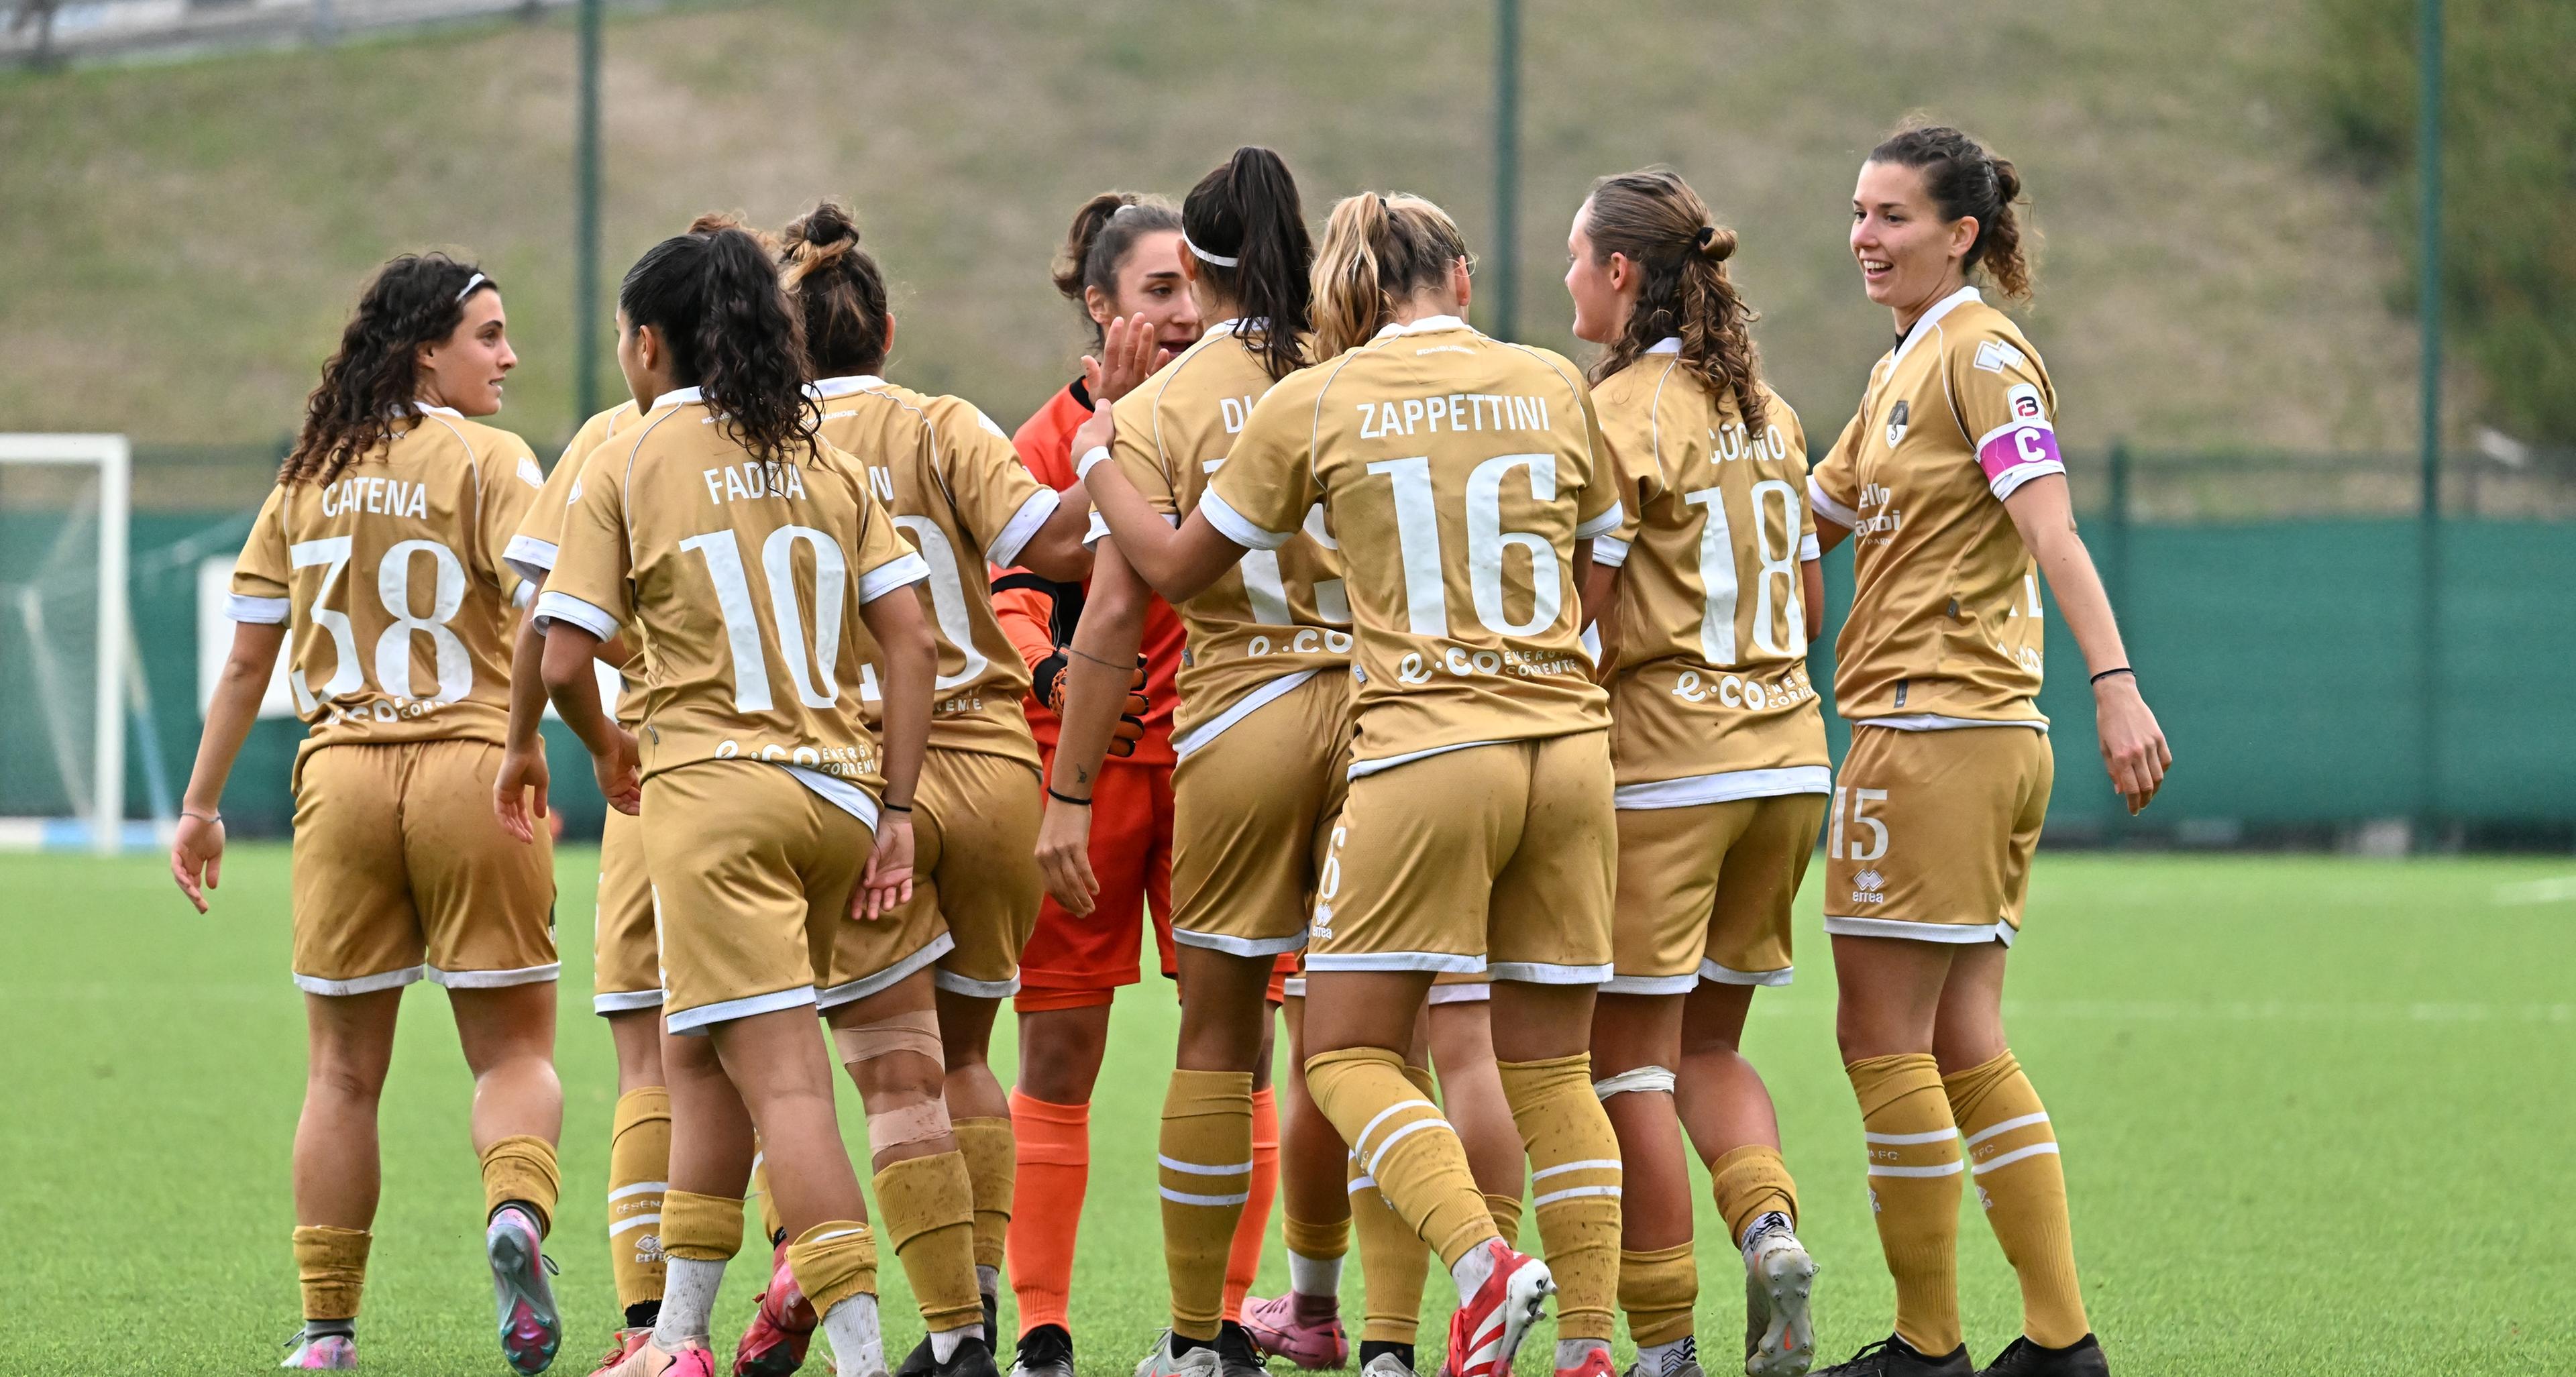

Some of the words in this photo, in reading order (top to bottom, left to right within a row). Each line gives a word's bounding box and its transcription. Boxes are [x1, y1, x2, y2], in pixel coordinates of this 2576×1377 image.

[1356, 394, 1550, 439] ZAPPETTINI
[2015, 426, 2046, 461] C
[322, 477, 427, 520] CATENA
[703, 461, 806, 505] FADDA
[1366, 453, 1562, 639] 16
[1684, 480, 1807, 665] 18
[290, 535, 473, 713] 38
[678, 524, 846, 714] 10
[1832, 786, 1889, 861] 15
[616, 1200, 661, 1214] CESEN
